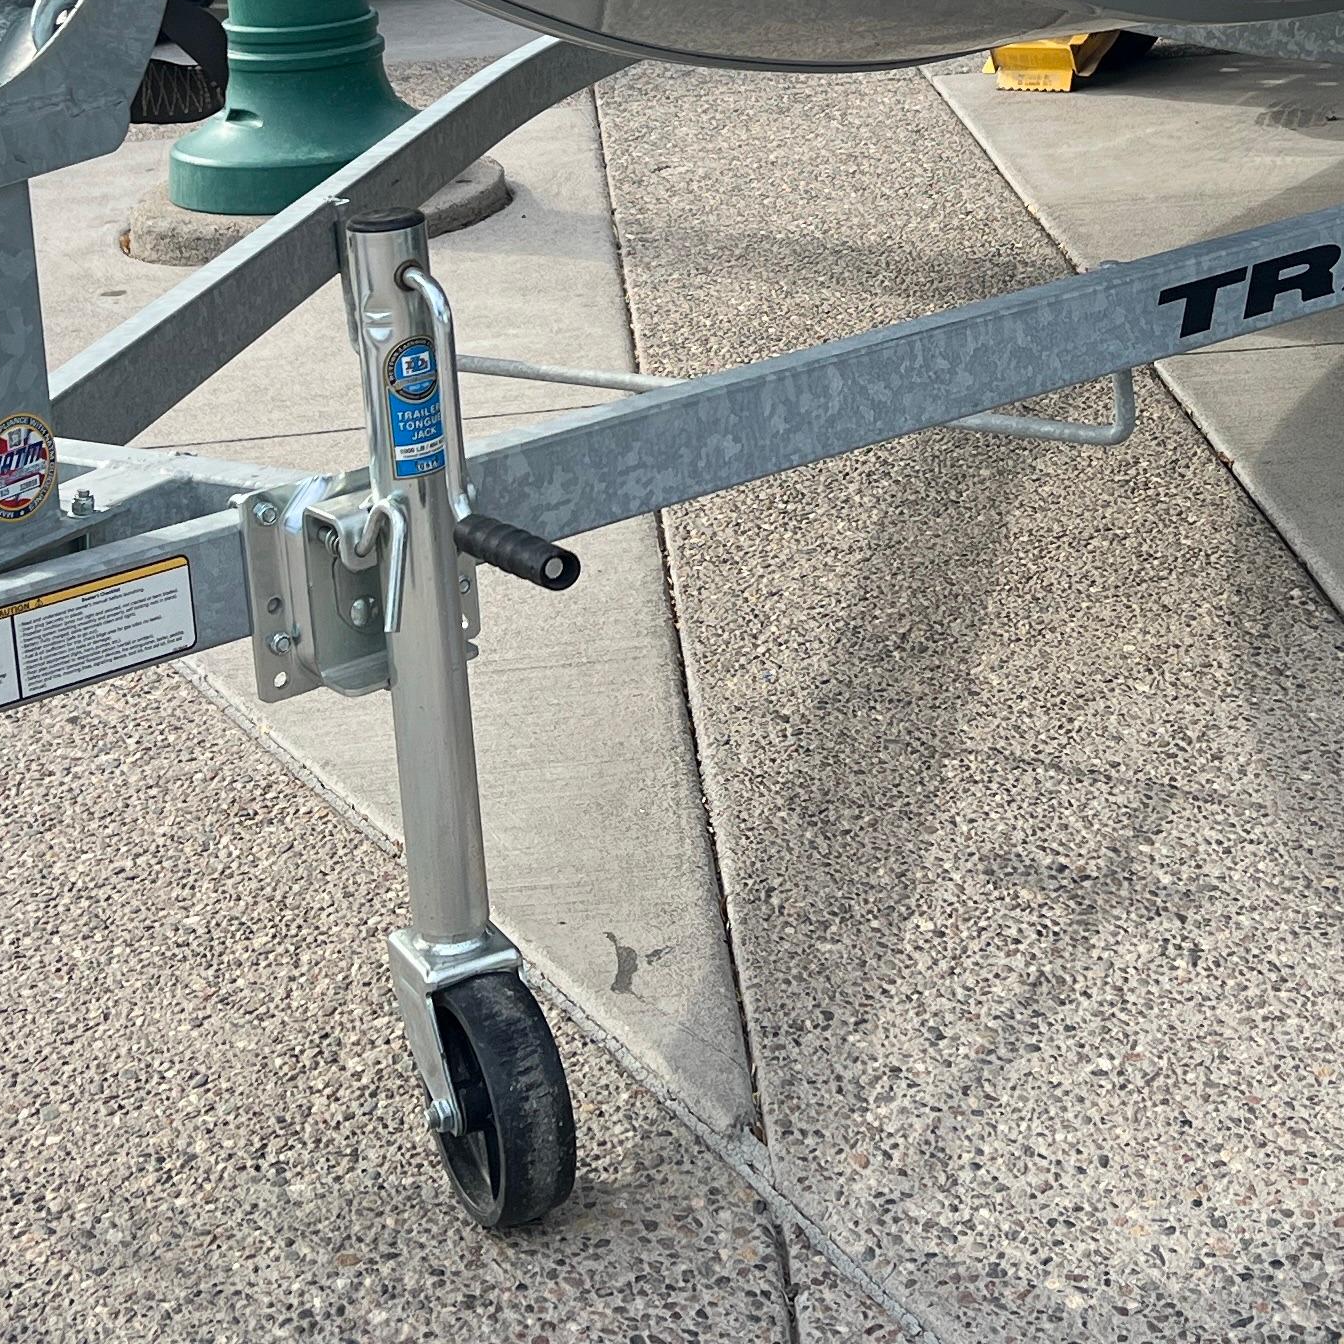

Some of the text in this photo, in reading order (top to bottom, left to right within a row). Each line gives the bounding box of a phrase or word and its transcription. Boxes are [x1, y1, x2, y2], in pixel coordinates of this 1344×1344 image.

[397, 402, 441, 421] TRAILER
[398, 412, 442, 431] TONGUE
[411, 424, 437, 441] JACK
